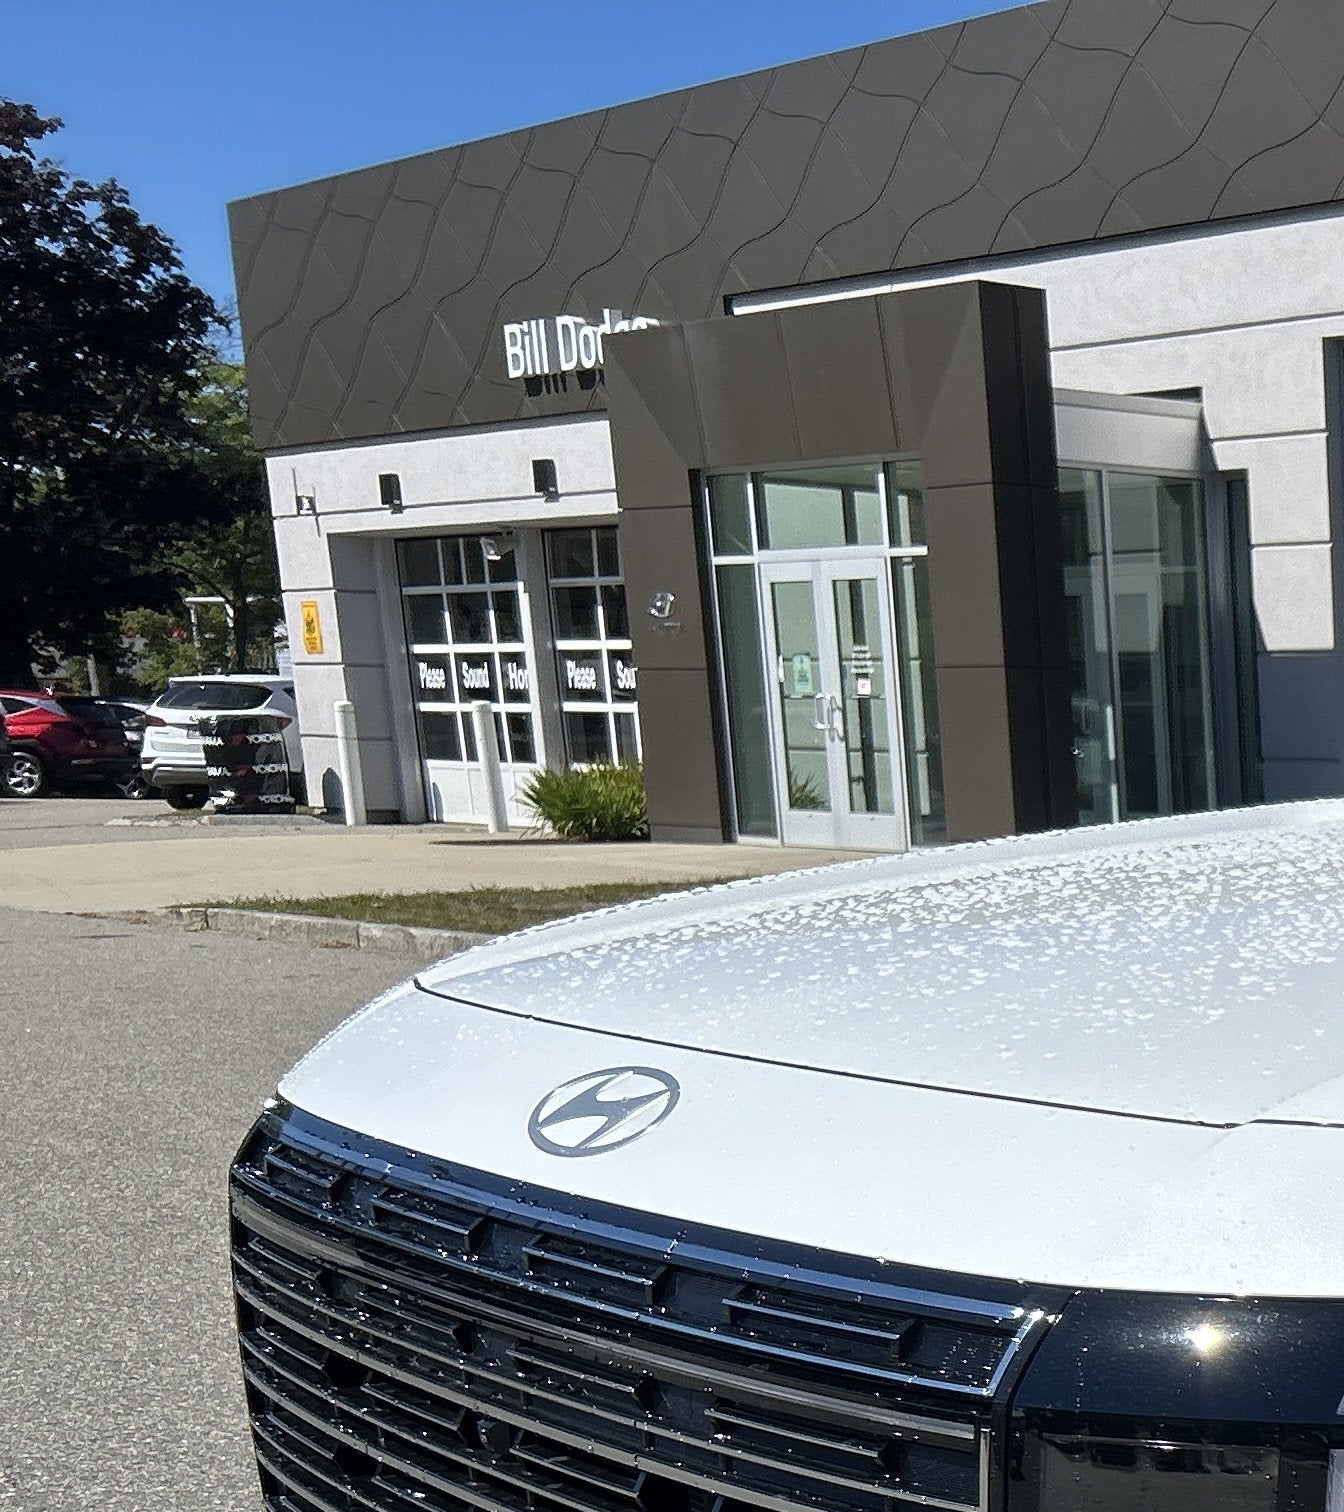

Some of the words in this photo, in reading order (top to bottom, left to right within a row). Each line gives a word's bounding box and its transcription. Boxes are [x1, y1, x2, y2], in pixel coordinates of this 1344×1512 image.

[503, 318, 549, 379] Bill
[555, 308, 660, 371] Dod
[419, 661, 446, 689] Please
[462, 661, 490, 689] Sound
[508, 662, 530, 689] Hor
[565, 660, 597, 690] Please
[616, 660, 638, 690] Sou
